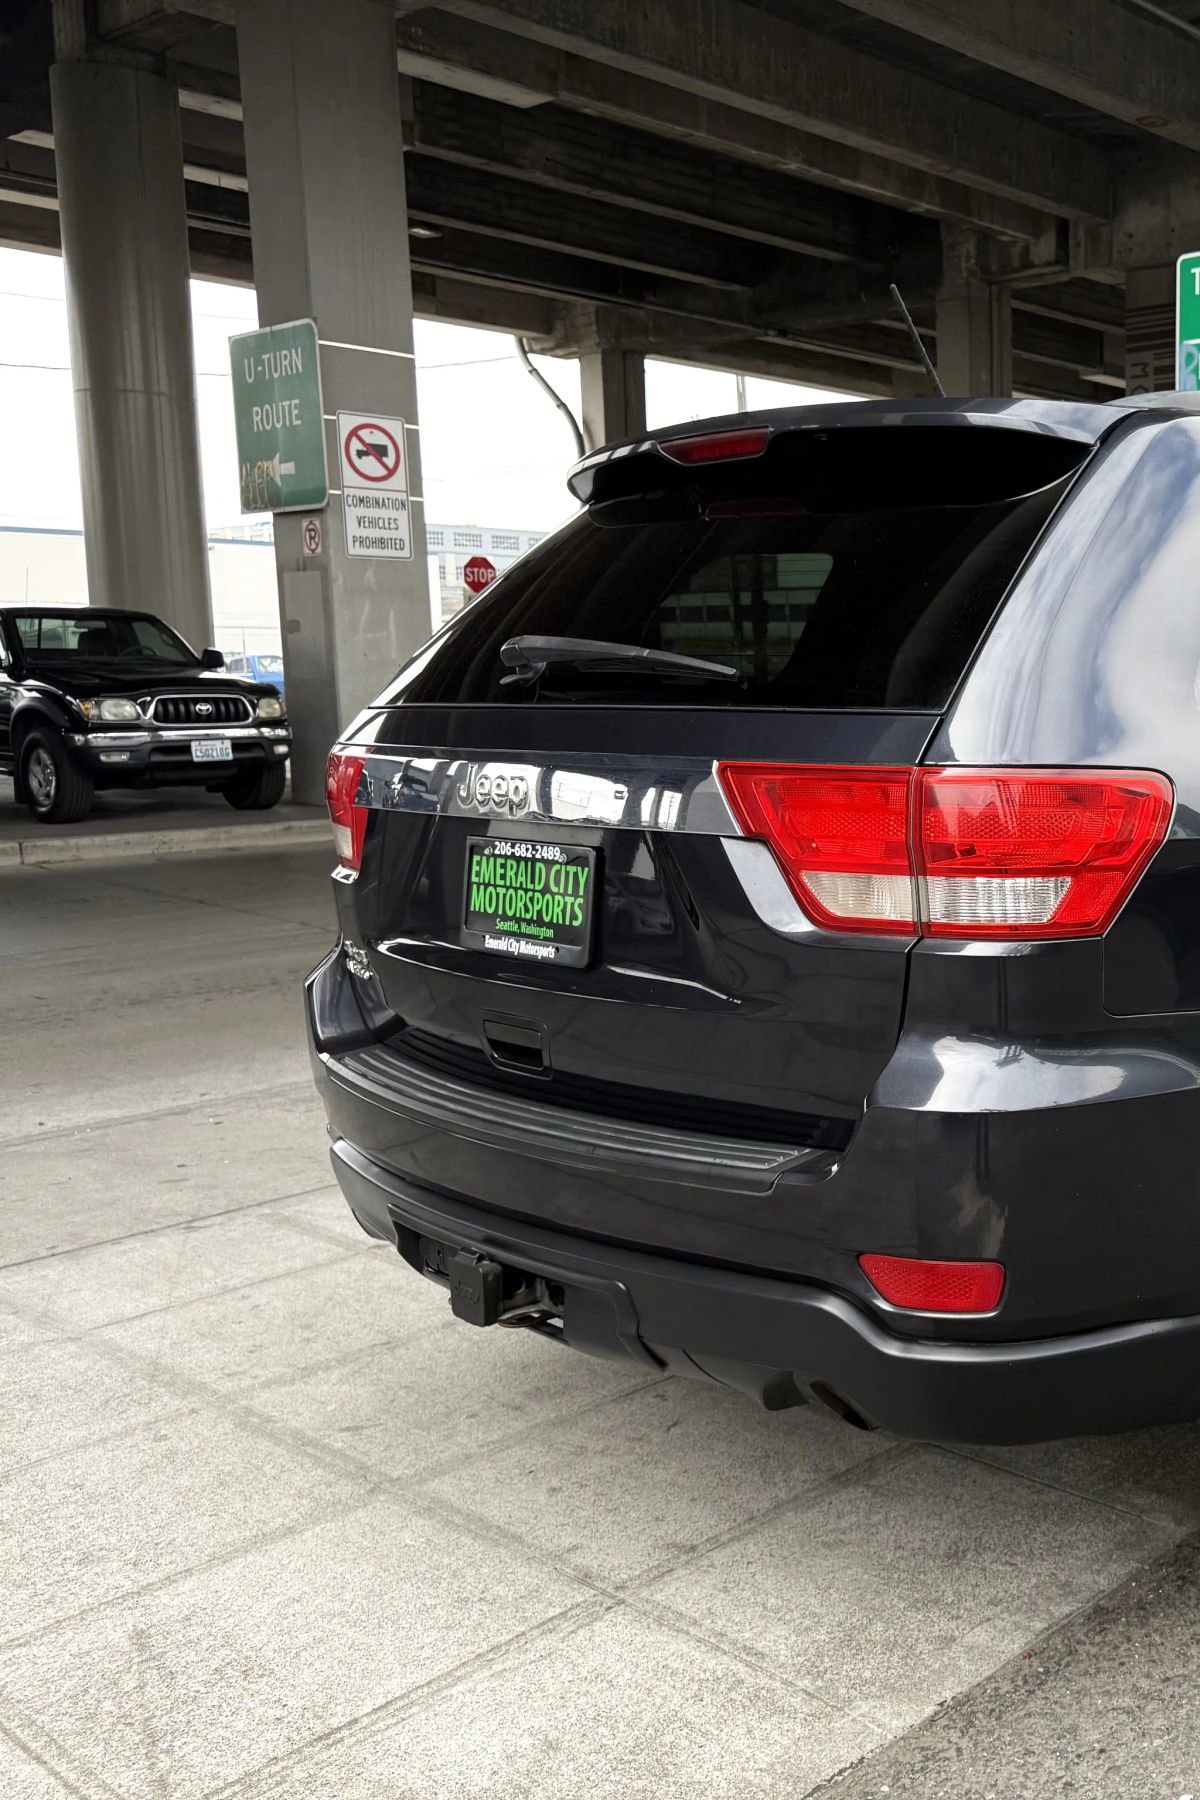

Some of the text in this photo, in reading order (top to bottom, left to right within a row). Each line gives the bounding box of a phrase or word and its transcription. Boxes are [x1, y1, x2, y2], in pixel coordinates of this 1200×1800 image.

[244, 347, 302, 384] U-TURN
[252, 398, 301, 432] ROUTE
[345, 493, 407, 512] COMBINATION
[356, 514, 400, 531] VEHICLES
[352, 535, 406, 551] PROHIBITED
[465, 567, 495, 583] STOP
[456, 762, 530, 817] Jeep
[494, 841, 561, 861] 206-682-2489
[471, 855, 590, 896] EMERALD CITY
[470, 884, 584, 927] MOTORSPORTS
[496, 918, 554, 939] Seattle, Washington
[484, 934, 556, 959] Emerald City Motorsports
